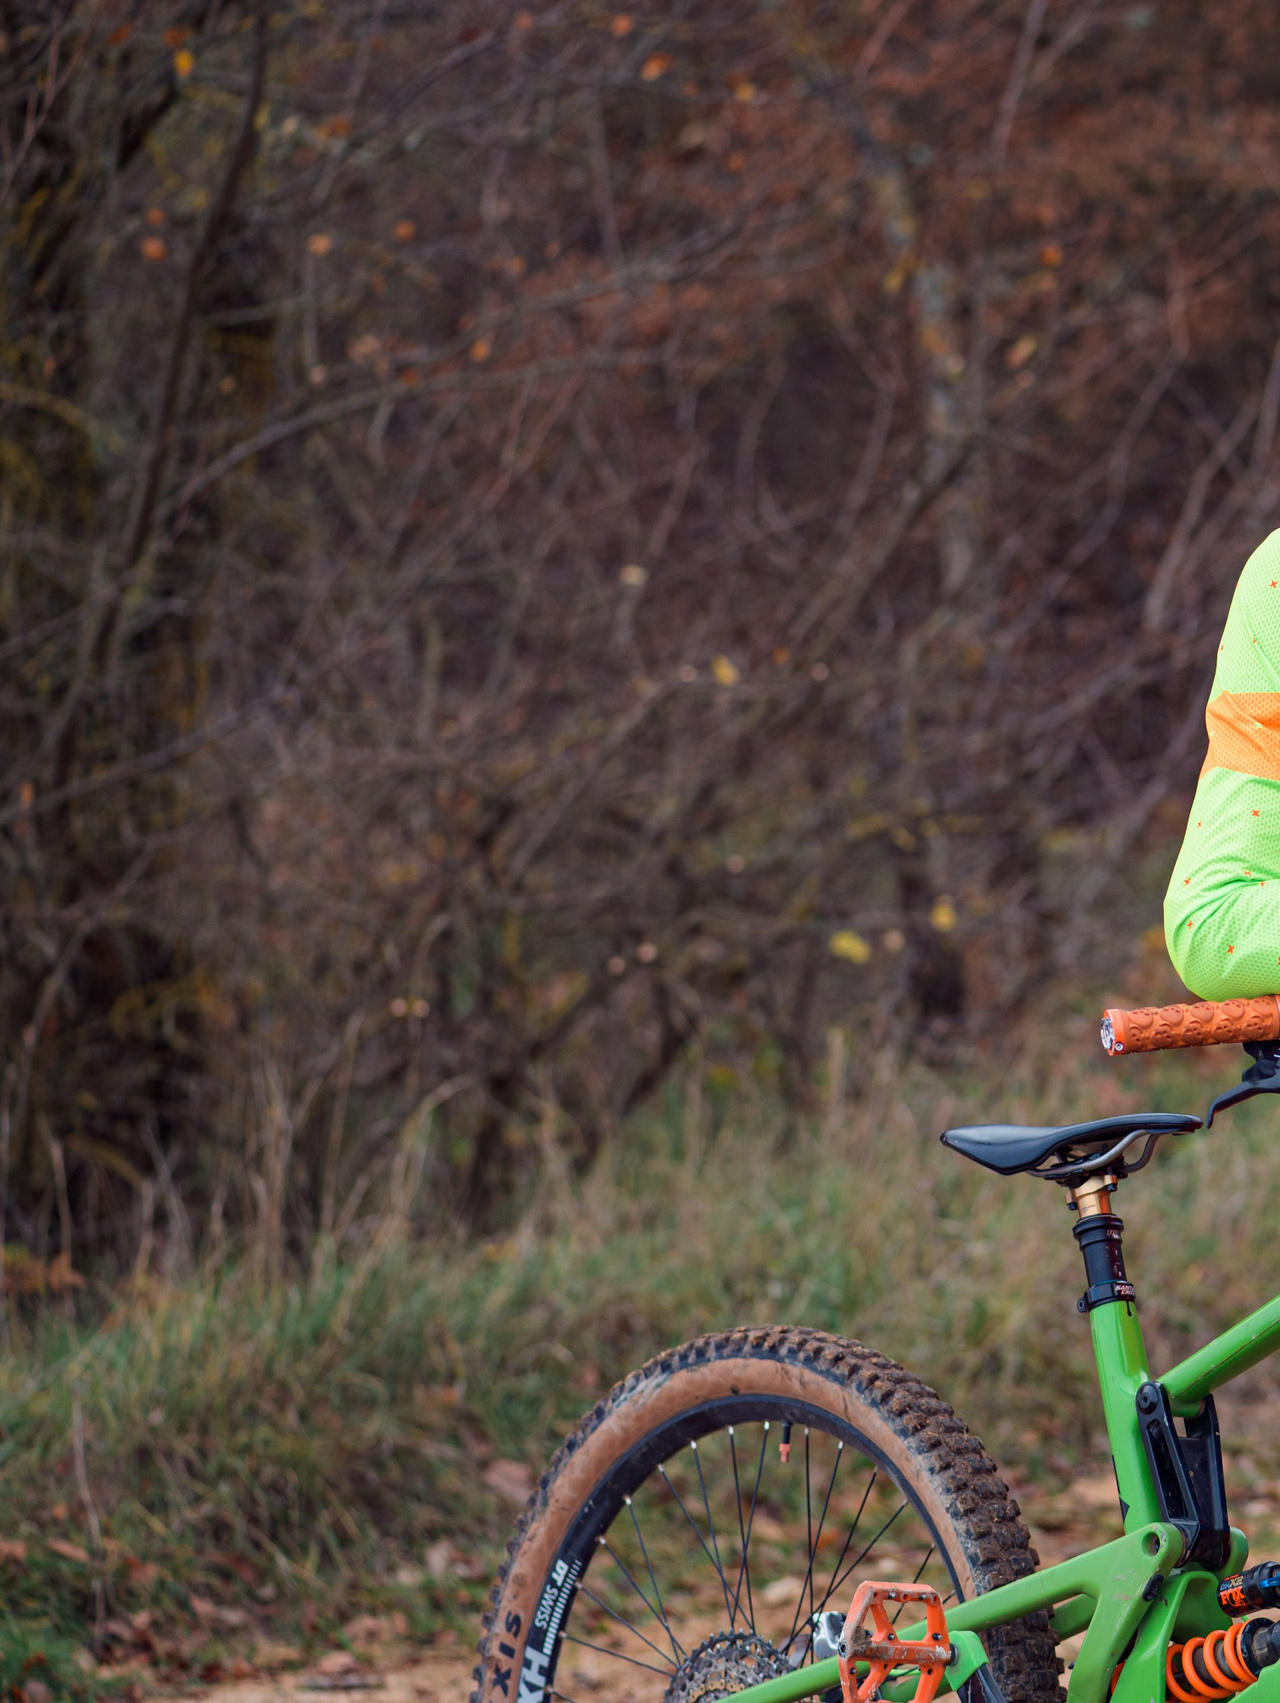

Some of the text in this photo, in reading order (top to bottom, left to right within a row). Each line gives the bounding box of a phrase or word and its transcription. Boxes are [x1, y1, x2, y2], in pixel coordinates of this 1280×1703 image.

[535, 1559, 569, 1629] DT SWISS
[1220, 1586, 1246, 1607] FOX
